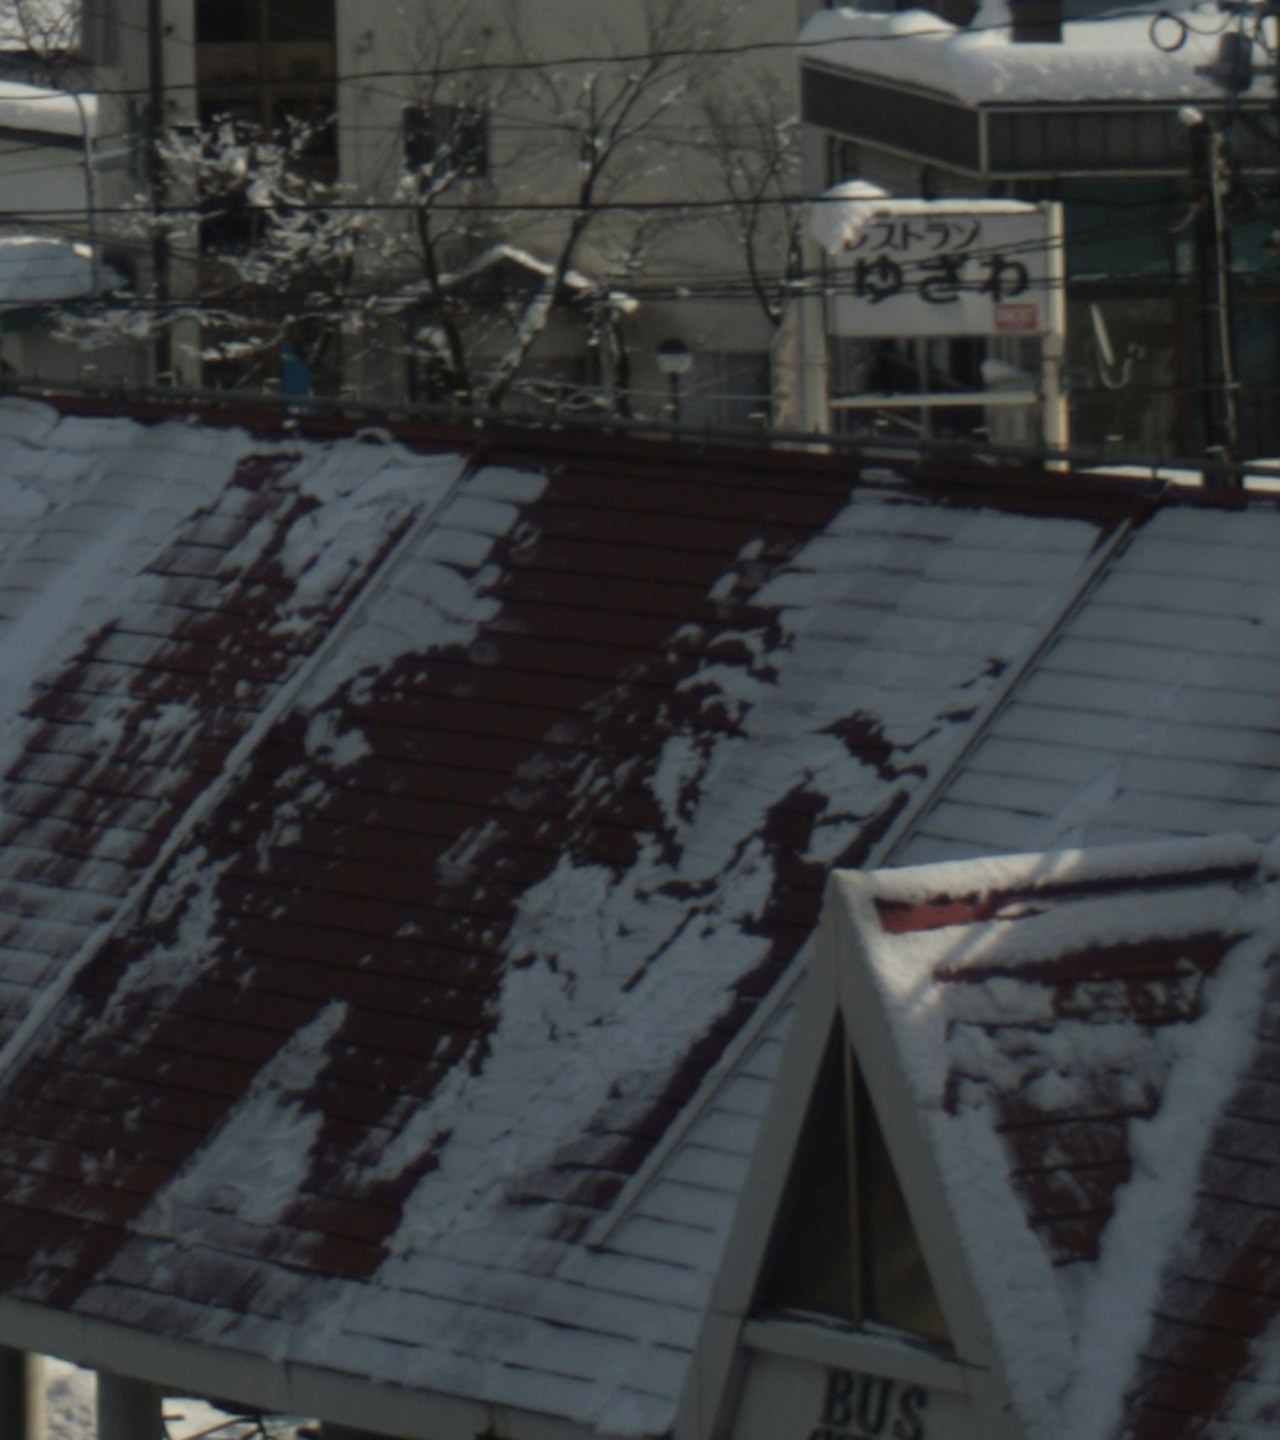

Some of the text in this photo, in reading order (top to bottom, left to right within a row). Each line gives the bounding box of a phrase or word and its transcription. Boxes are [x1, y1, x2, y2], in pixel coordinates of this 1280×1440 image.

[855, 254, 1030, 304] ゆざわ
[820, 1368, 928, 1440] BUS
